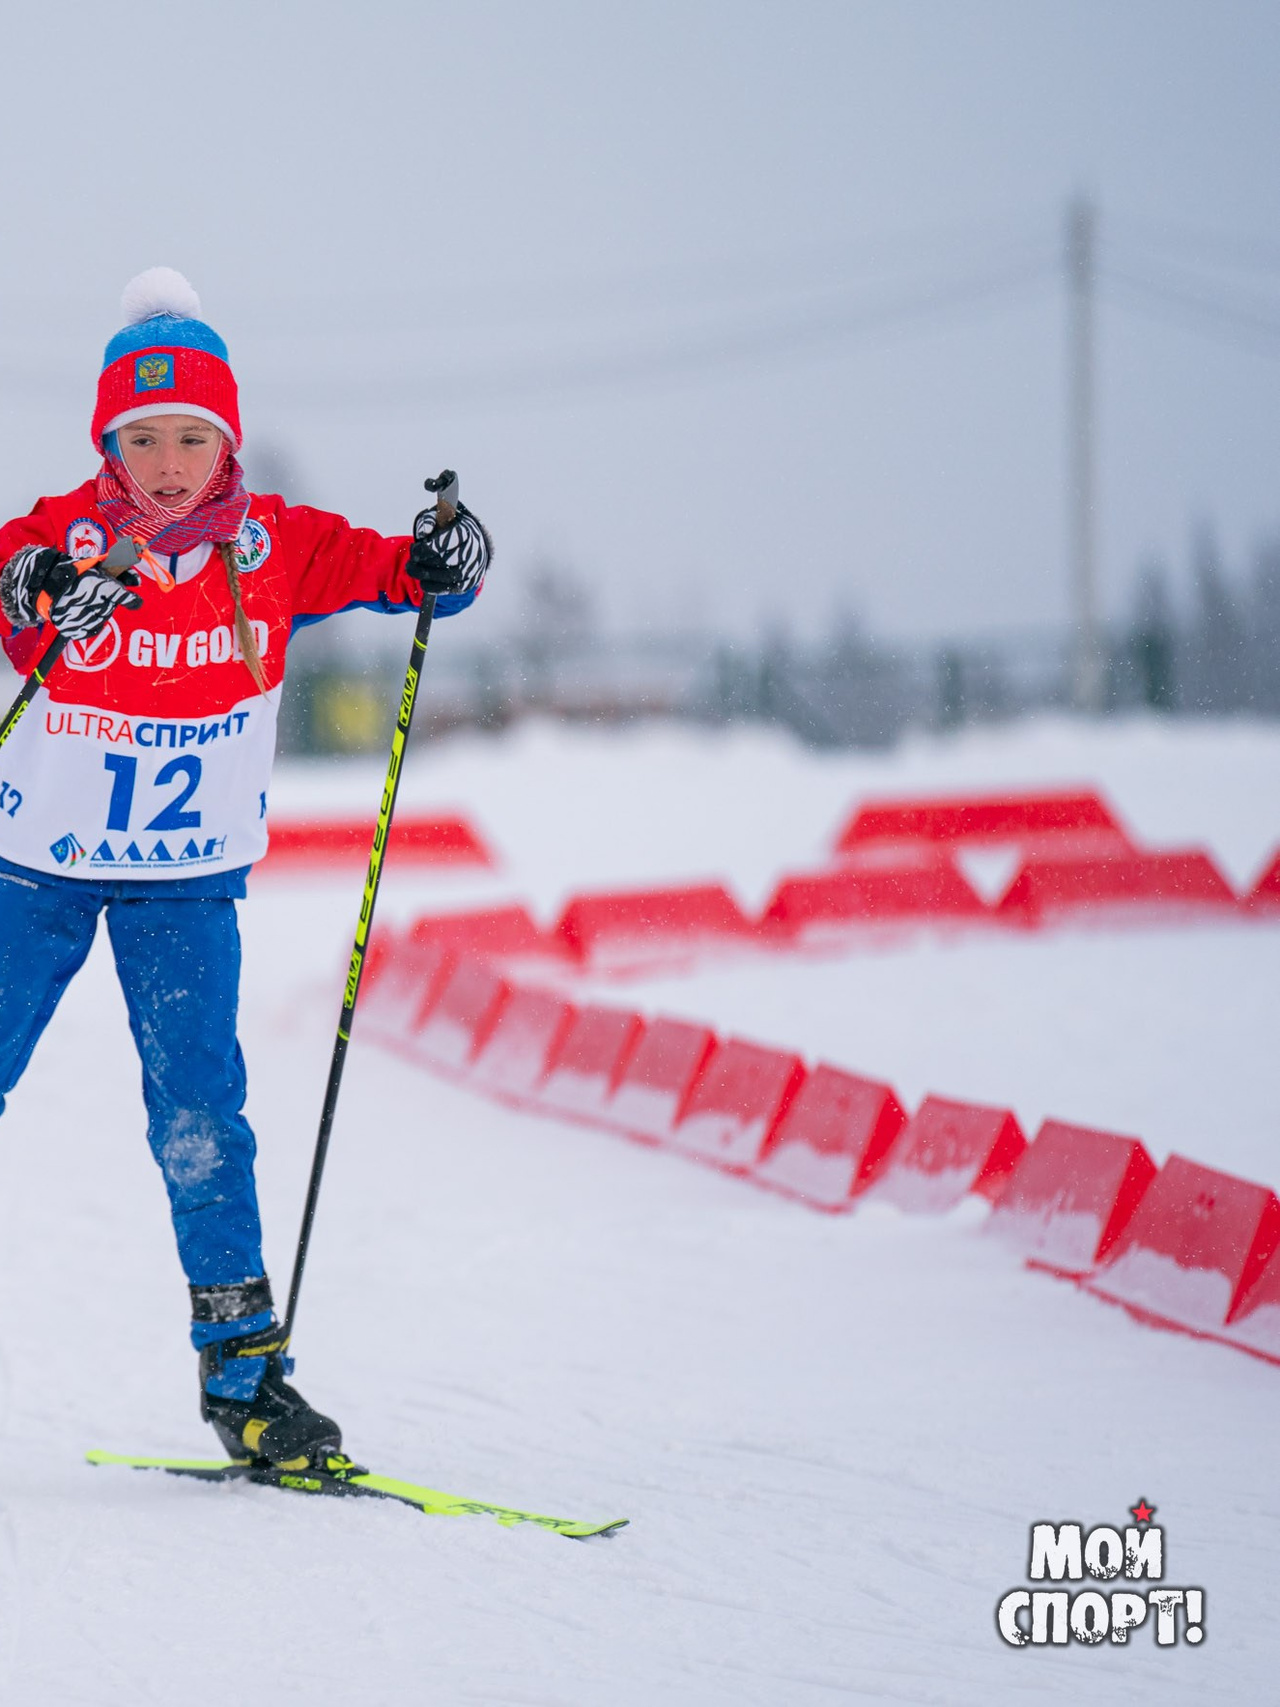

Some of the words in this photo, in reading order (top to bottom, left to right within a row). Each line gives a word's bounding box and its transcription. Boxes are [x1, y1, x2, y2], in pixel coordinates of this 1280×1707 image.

[128, 628, 181, 668] GV
[0, 780, 23, 818] 12
[104, 752, 202, 832] 12
[259, 791, 267, 819] 1
